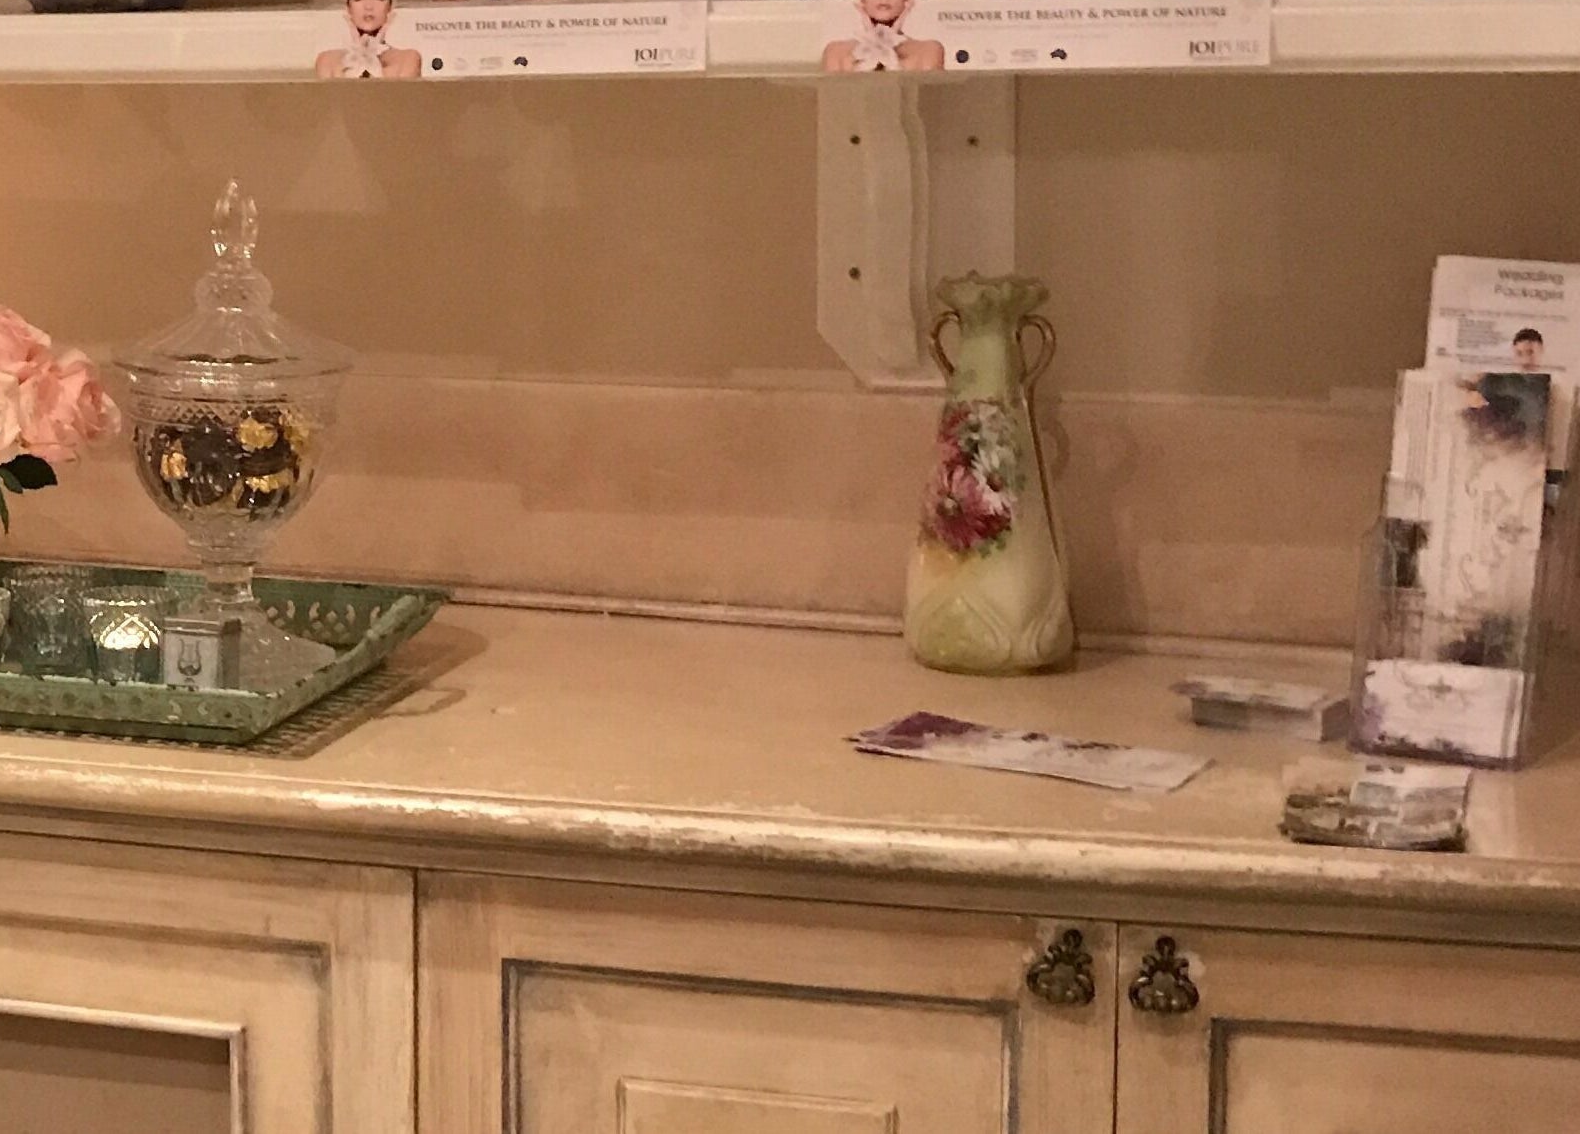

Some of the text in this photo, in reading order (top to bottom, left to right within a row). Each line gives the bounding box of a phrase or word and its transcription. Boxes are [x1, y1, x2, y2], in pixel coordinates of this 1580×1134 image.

[938, 6, 1226, 21] DISCOVER THE BEAUTY & POWER OF NATURE
[416, 16, 667, 32] DISCOVER THE BEAUTY & POWER OF NATURE
[1498, 269, 1564, 285] Wedding
[1494, 285, 1564, 301] Packages
